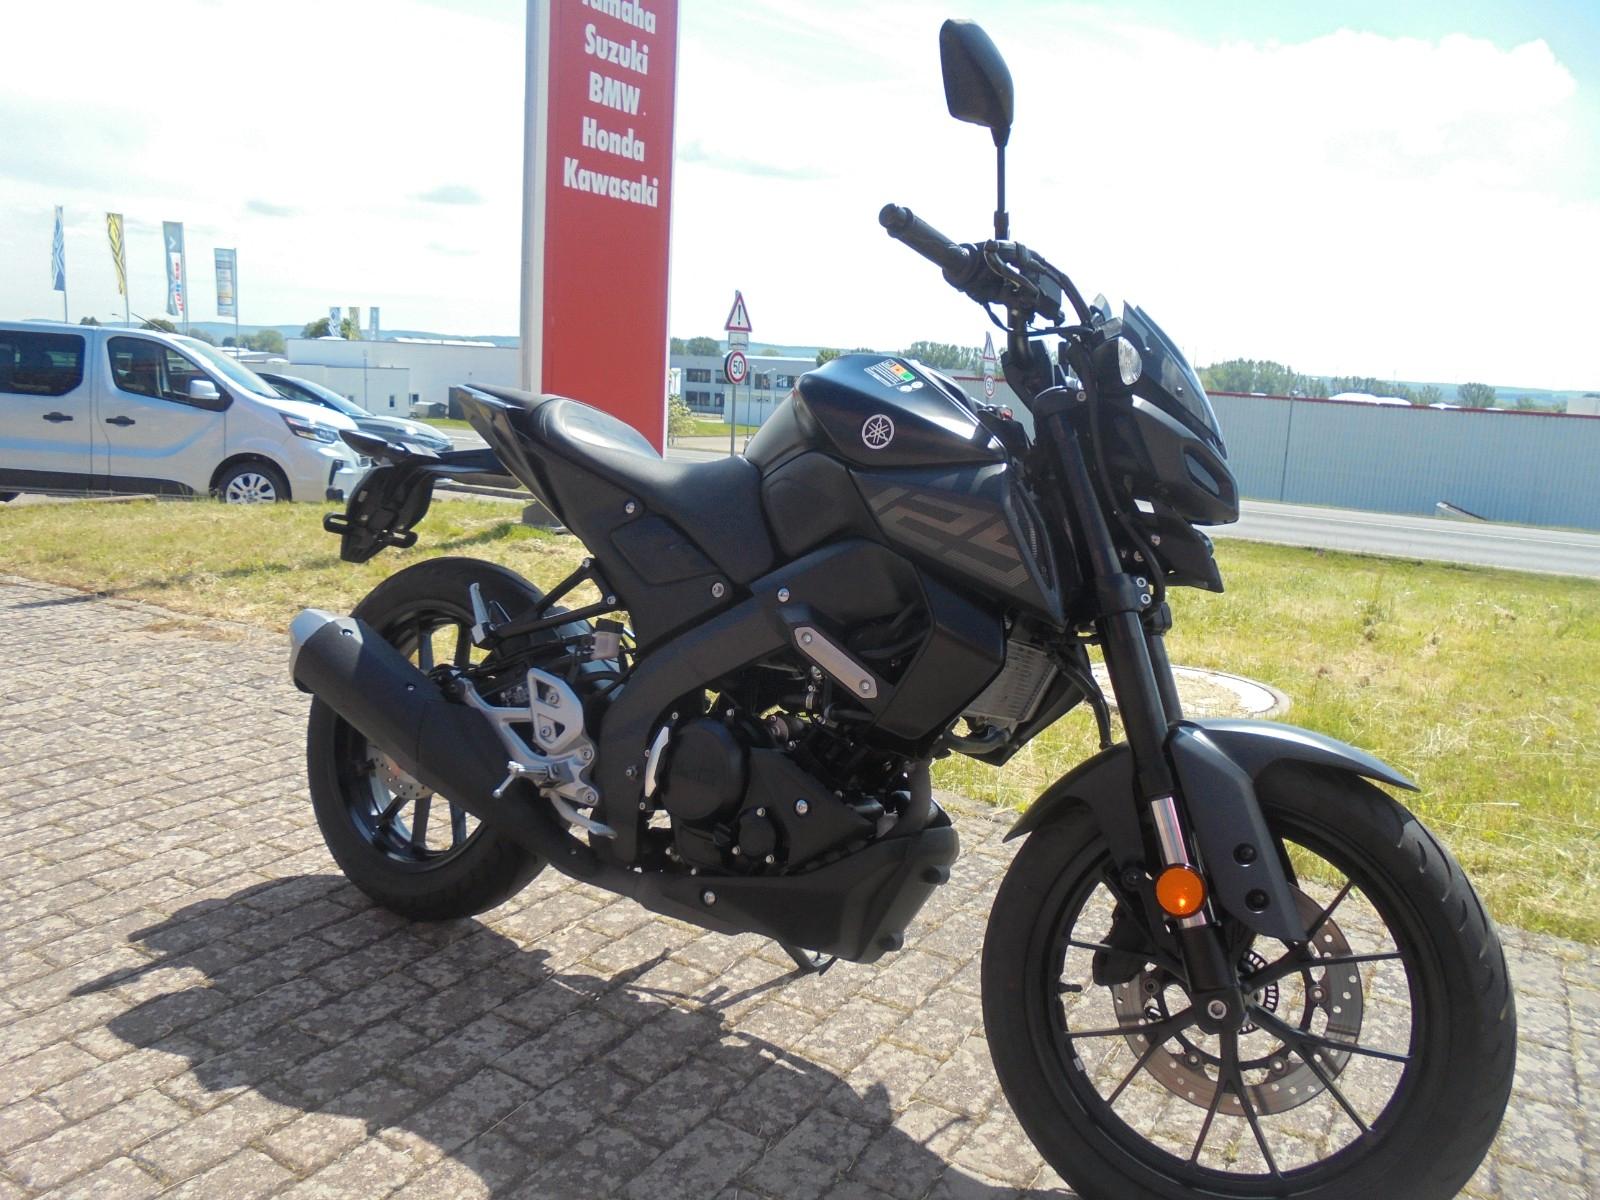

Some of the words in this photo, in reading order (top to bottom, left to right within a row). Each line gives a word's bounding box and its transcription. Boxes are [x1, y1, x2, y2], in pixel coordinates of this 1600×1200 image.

[582, 0, 657, 34] amaha
[585, 24, 648, 75] Suzuki
[589, 71, 640, 115] BMW
[582, 116, 644, 162] Honda
[563, 157, 658, 208] Kawasaki
[733, 360, 743, 375] 50
